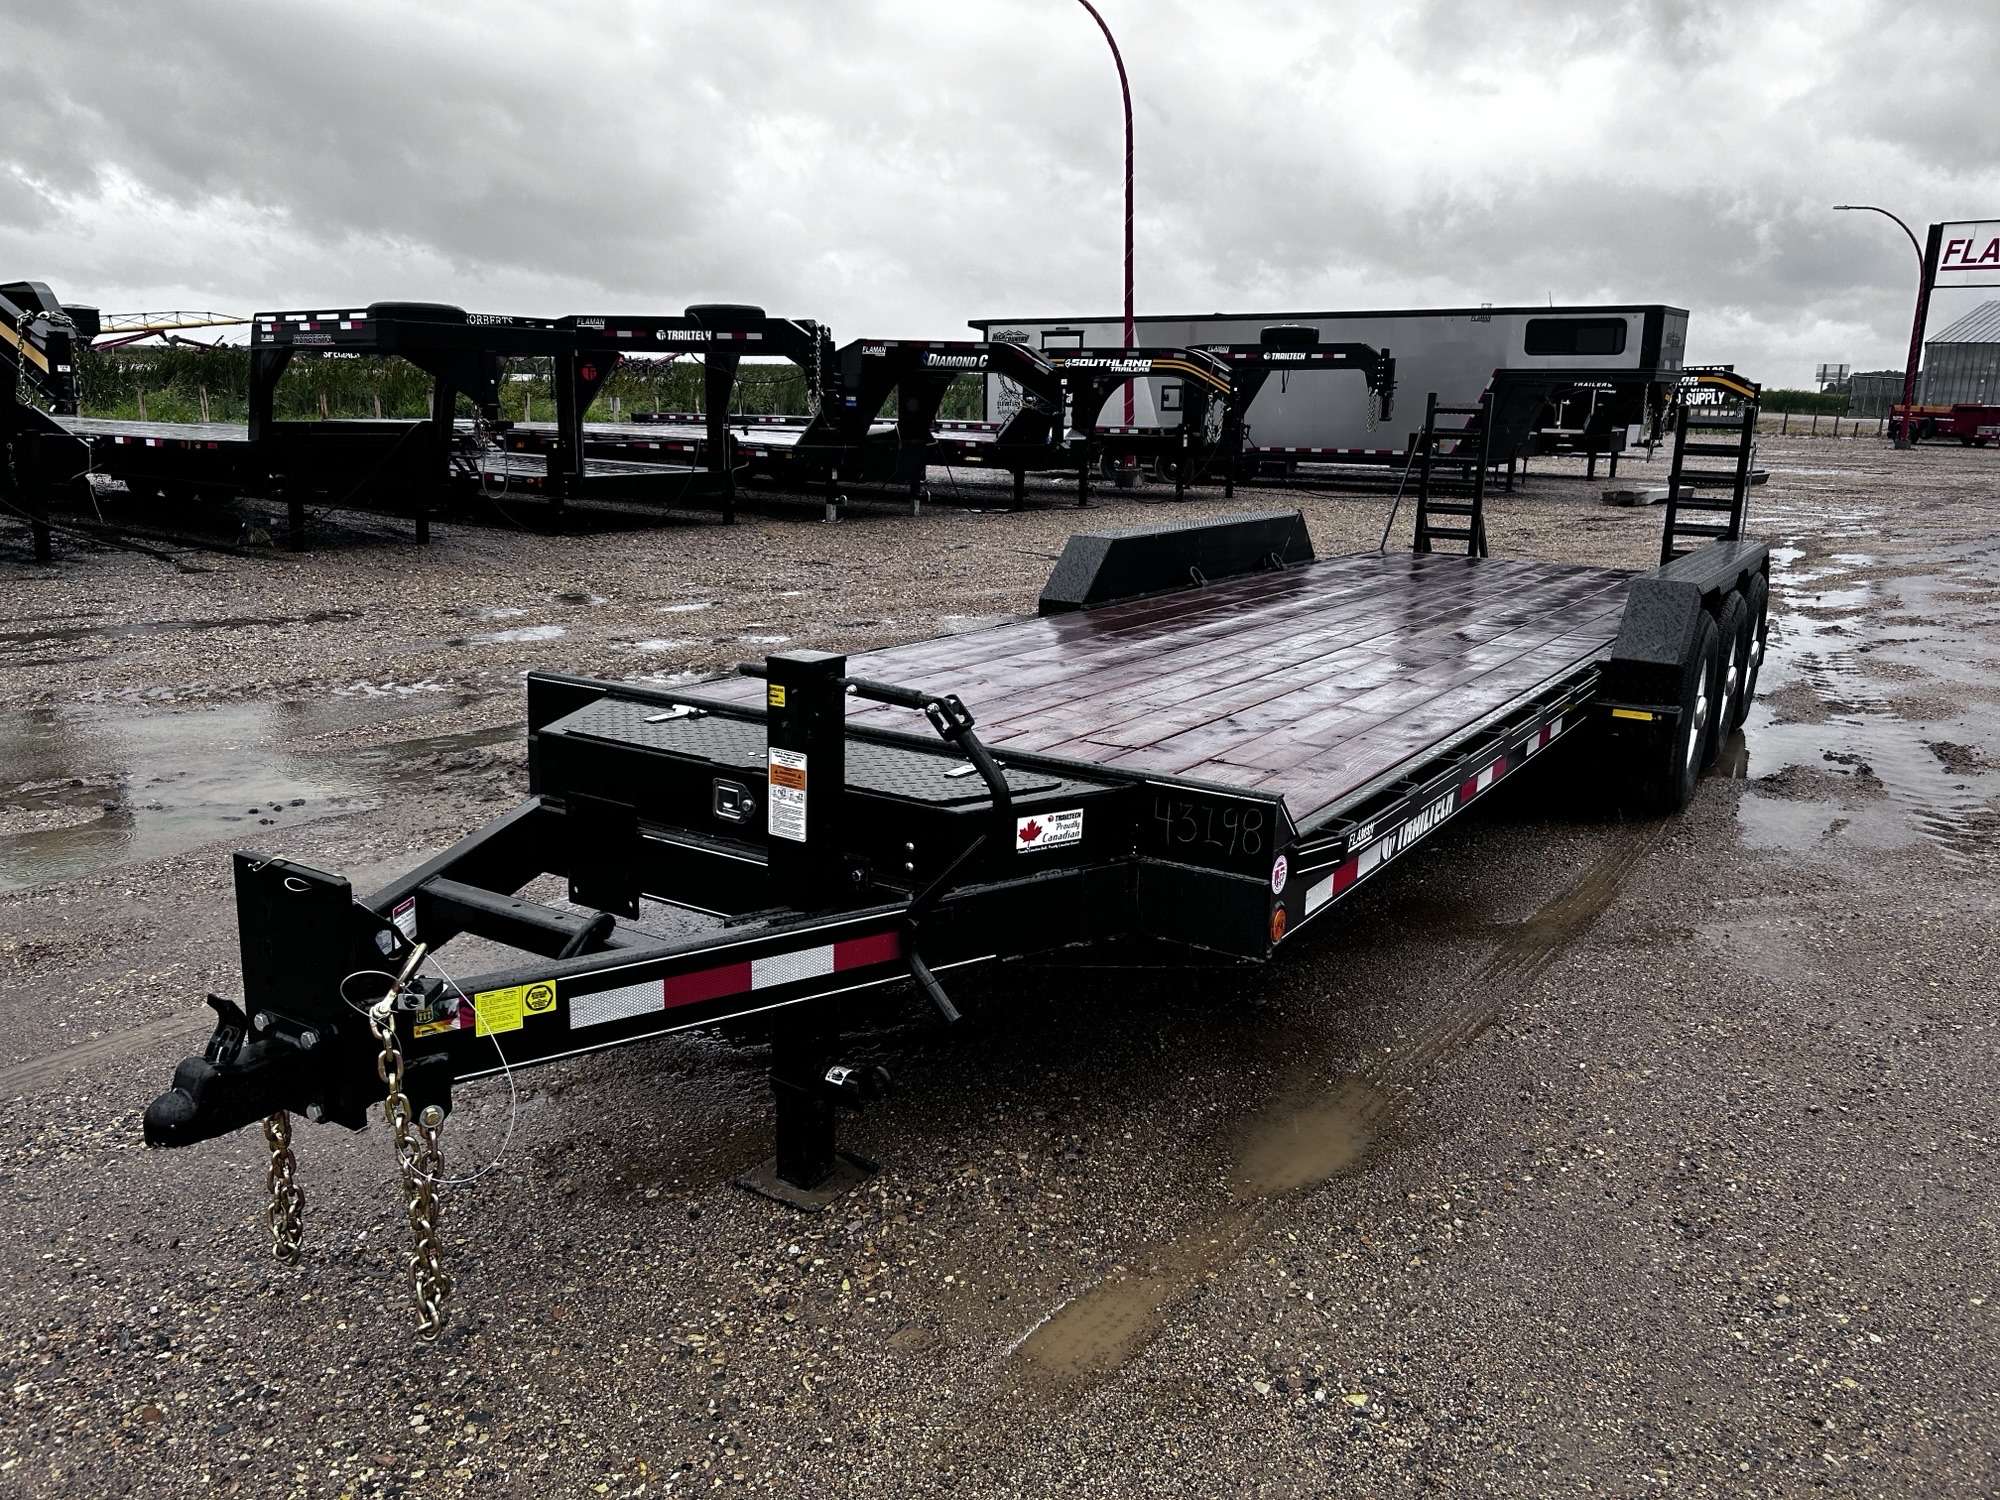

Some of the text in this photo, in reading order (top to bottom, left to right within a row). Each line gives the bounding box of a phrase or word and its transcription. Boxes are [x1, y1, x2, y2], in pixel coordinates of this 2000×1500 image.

[862, 346, 887, 354] FLAMAN
[927, 353, 989, 368] DIAMOND C
[1071, 358, 1153, 367] SOUTHLAND
[1685, 391, 1725, 405] SUPPLY
[1042, 830, 1080, 843] Canadian
